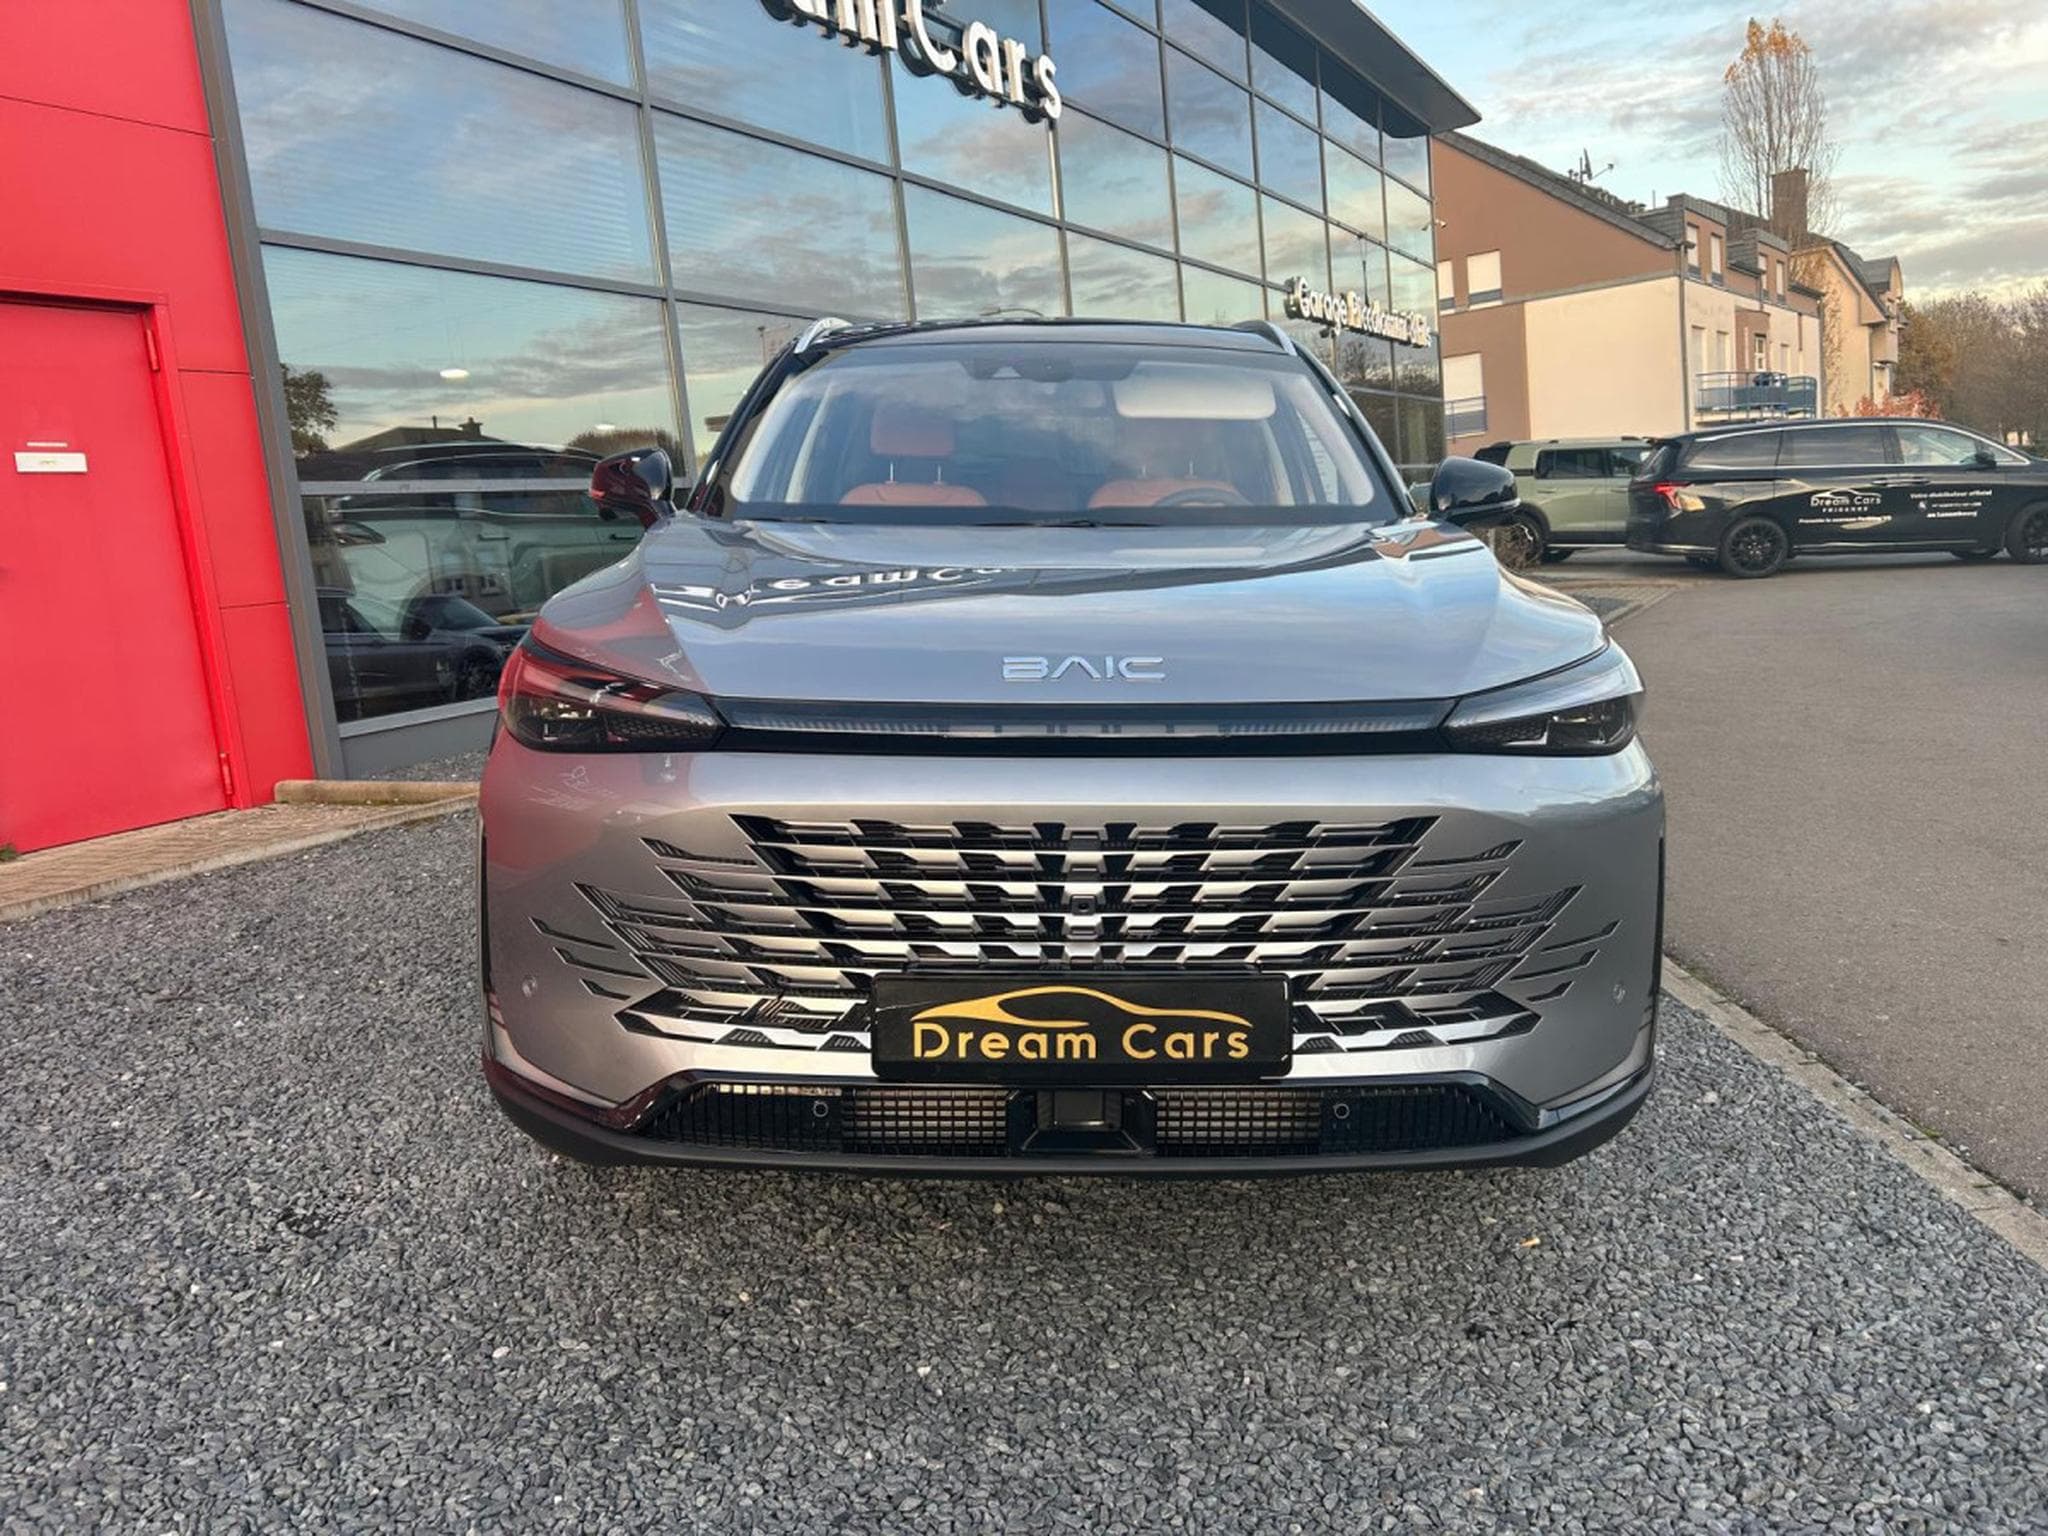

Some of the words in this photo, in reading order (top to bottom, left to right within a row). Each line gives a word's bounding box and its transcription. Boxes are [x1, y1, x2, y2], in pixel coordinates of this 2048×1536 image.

[904, 0, 1062, 120] Cars
[1293, 276, 1348, 337] Garage
[1810, 496, 1850, 507] Dream
[1853, 495, 1882, 505] Cars
[1002, 655, 1166, 680] BAIC
[912, 1022, 1097, 1059] Dream
[1121, 1022, 1249, 1059] Cars
